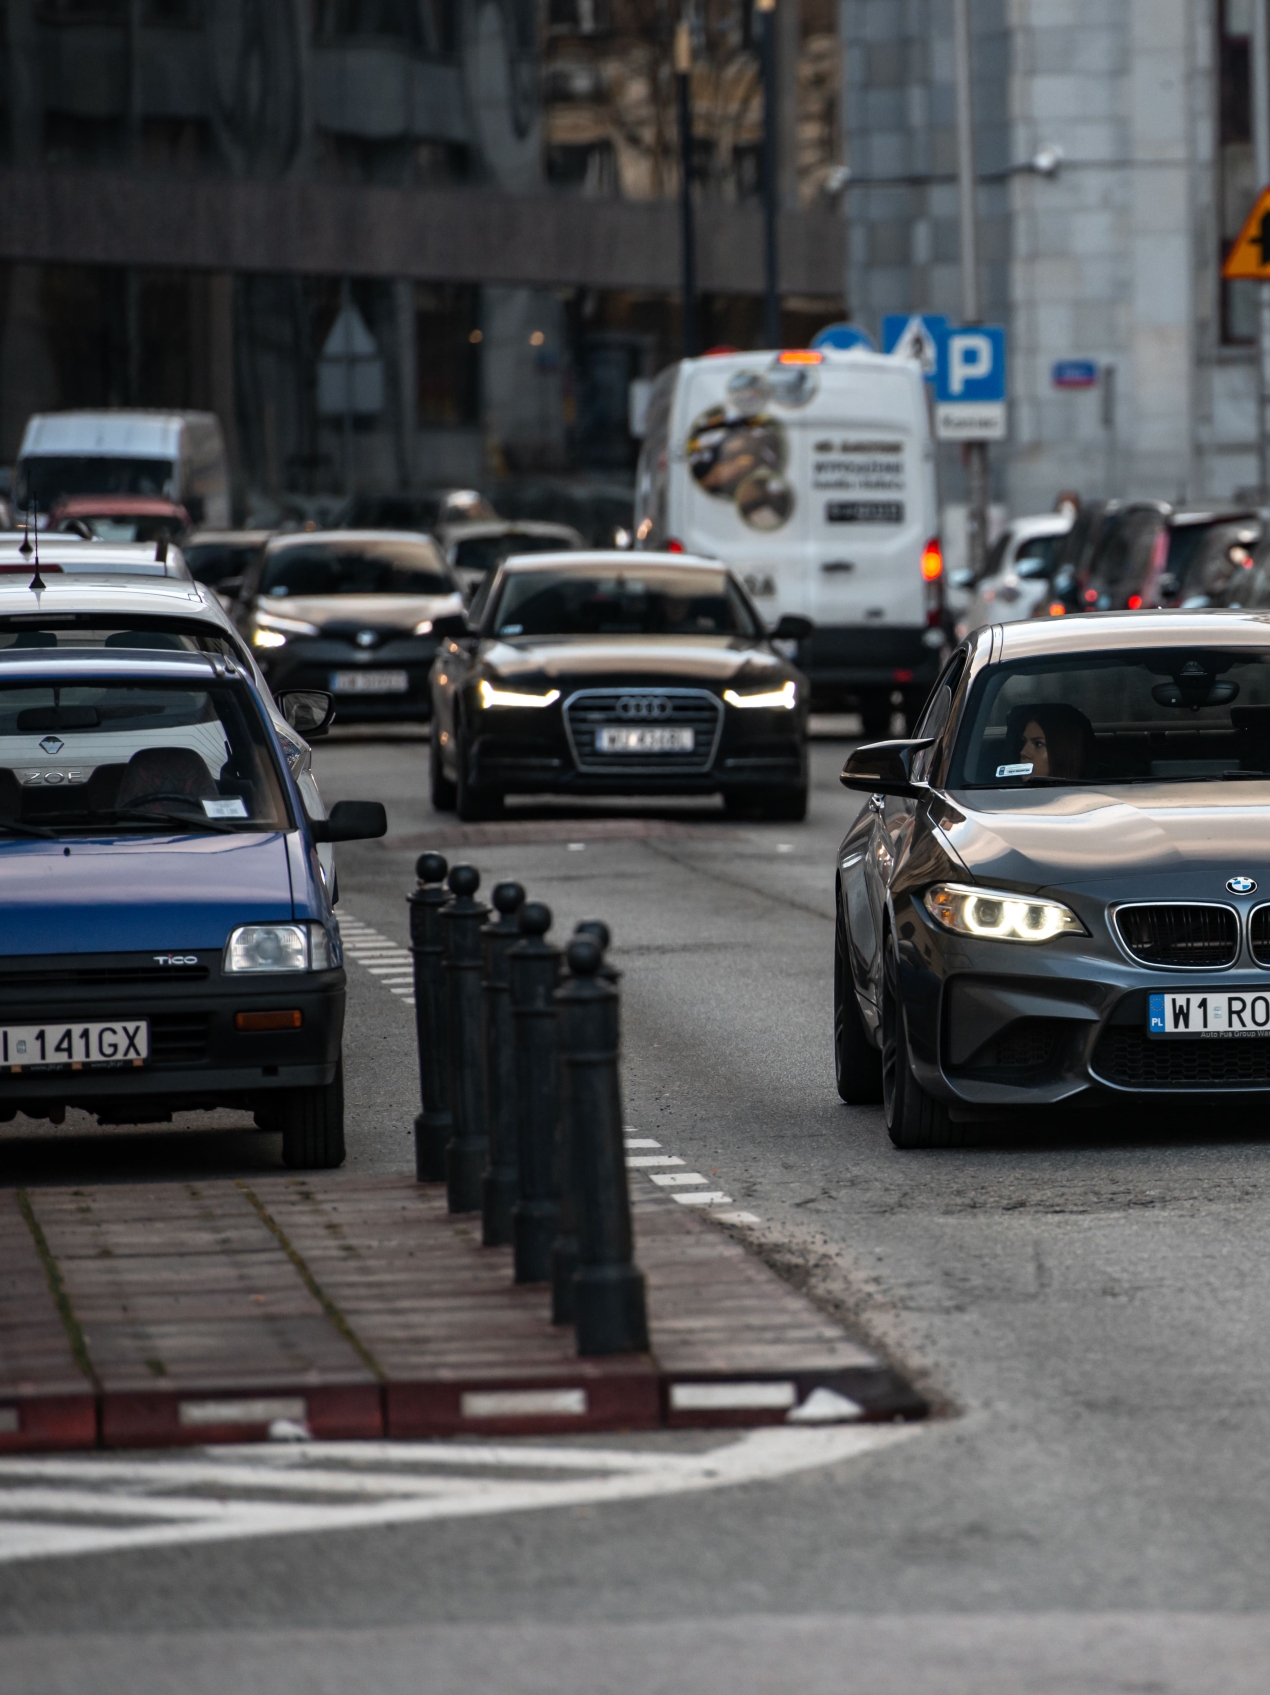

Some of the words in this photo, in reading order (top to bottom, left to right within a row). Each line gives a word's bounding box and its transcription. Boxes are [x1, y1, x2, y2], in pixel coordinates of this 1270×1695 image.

[947, 334, 992, 396] P
[23, 770, 84, 785] ZOE
[1151, 1018, 1163, 1027] PL
[1171, 998, 1208, 1029] W1
[35, 1025, 142, 1061] 141GX
[1234, 1030, 1256, 1039] Group
